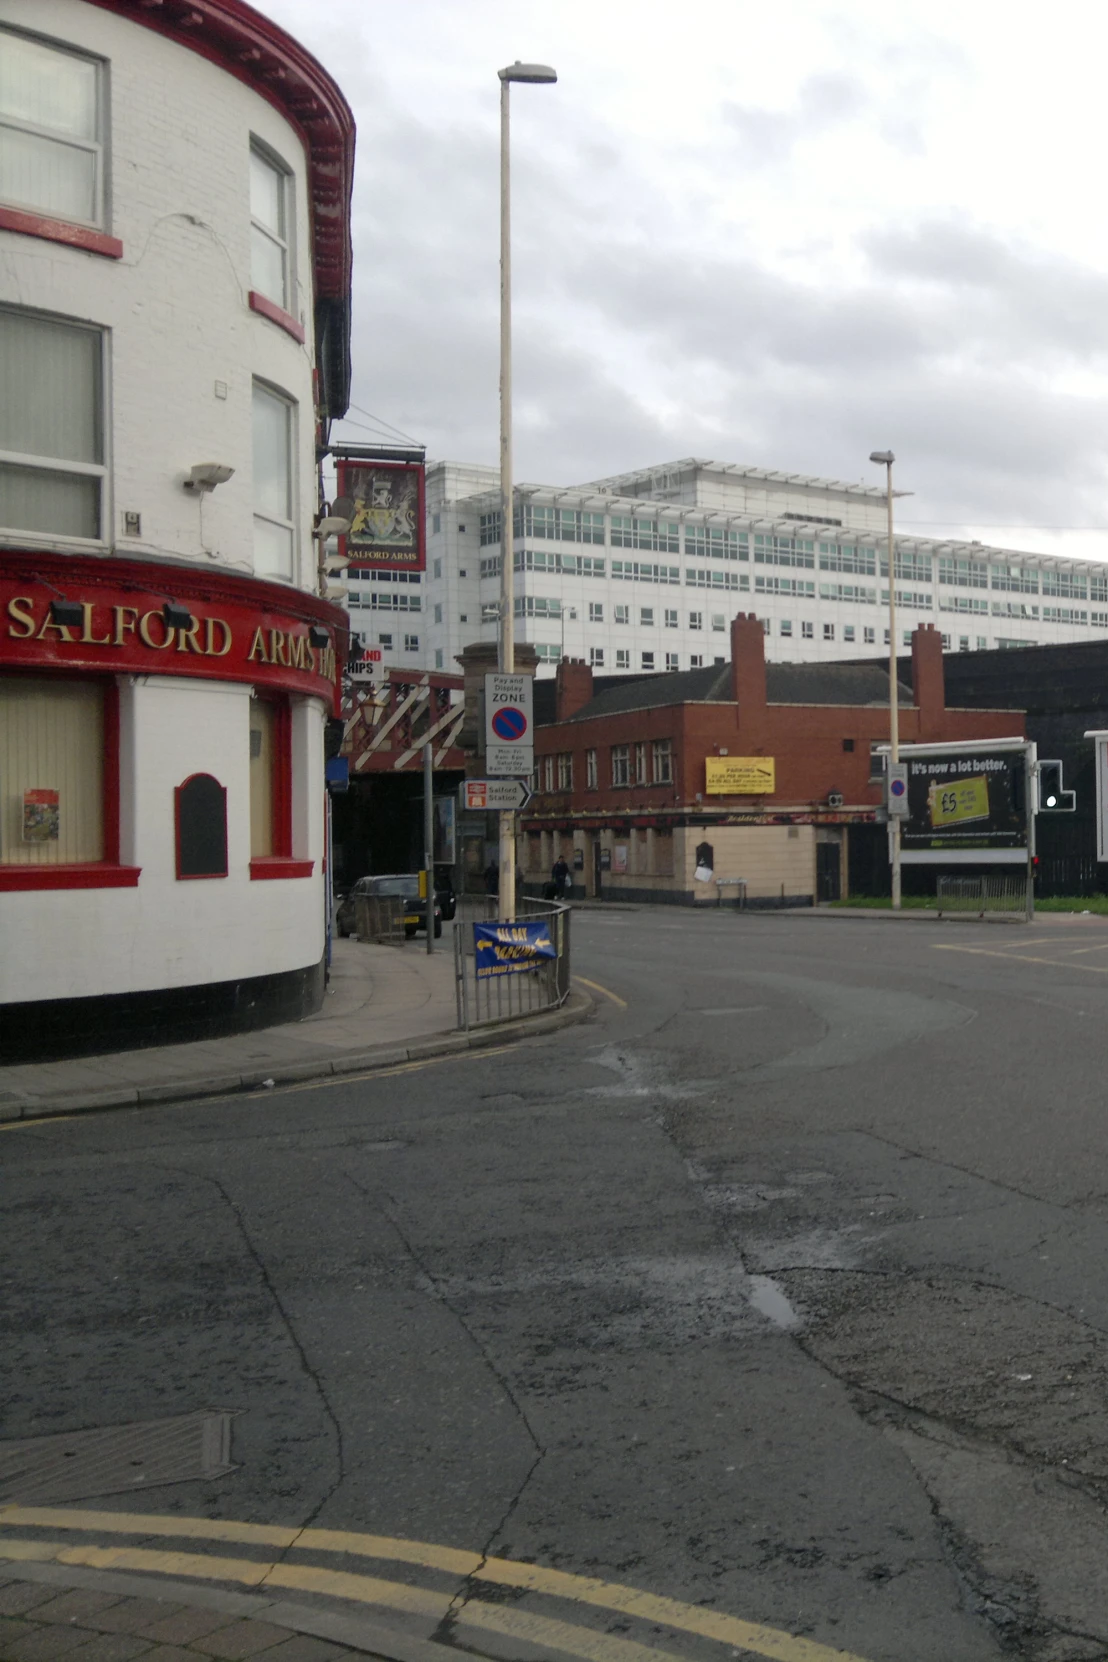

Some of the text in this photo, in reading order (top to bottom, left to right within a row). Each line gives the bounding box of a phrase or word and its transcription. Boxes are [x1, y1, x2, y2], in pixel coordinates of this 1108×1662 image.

[347, 549, 417, 561] SALFORD ARMS
[7, 596, 233, 656] SALFORD
[248, 626, 315, 671] ARMS
[492, 693, 526, 703] ZONE
[927, 764, 949, 774] now
[949, 763, 957, 773] a
[957, 760, 972, 773] lot
[972, 758, 1007, 772] better.
[941, 792, 957, 813] £5
